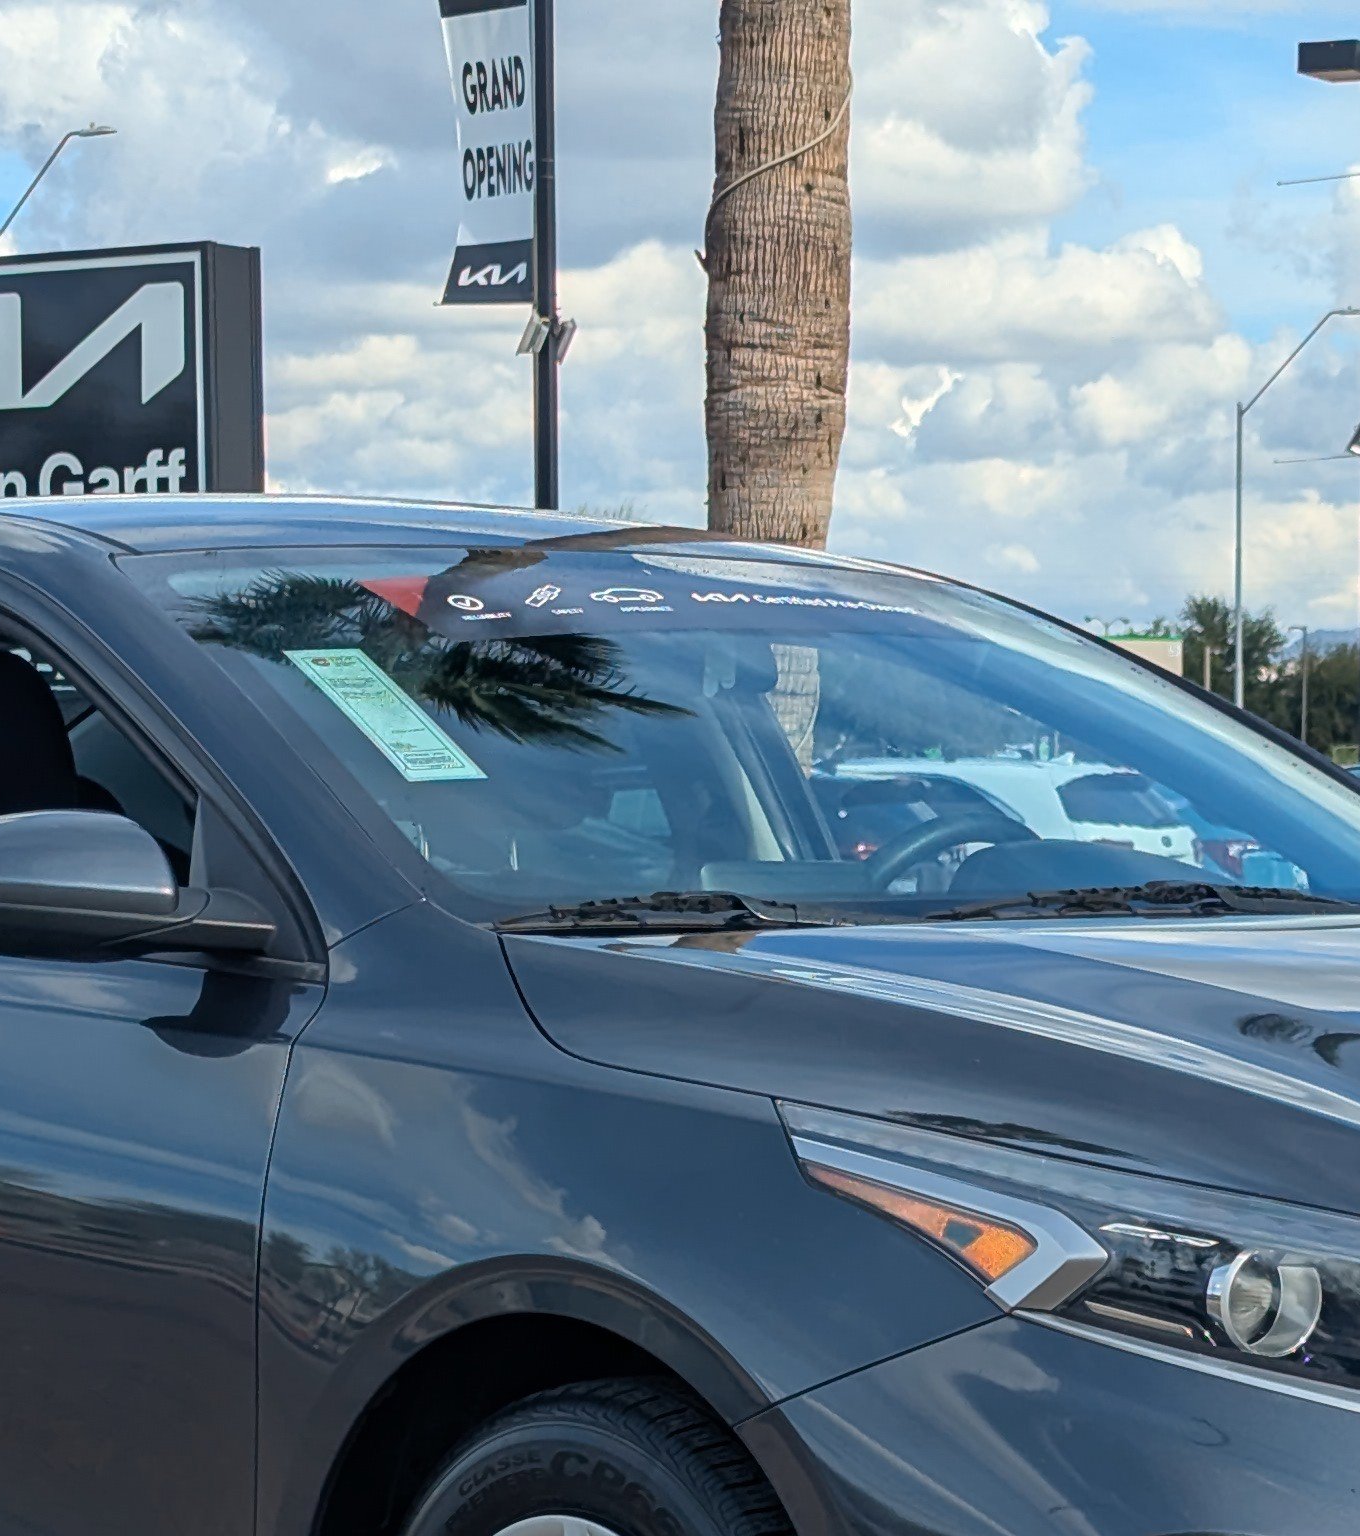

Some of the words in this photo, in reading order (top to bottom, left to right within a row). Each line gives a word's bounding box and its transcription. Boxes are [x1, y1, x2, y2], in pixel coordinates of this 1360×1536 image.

[462, 55, 525, 115] GRAND
[463, 139, 534, 201] OPENING
[458, 262, 527, 286] KIA
[39, 447, 186, 498] Garff
